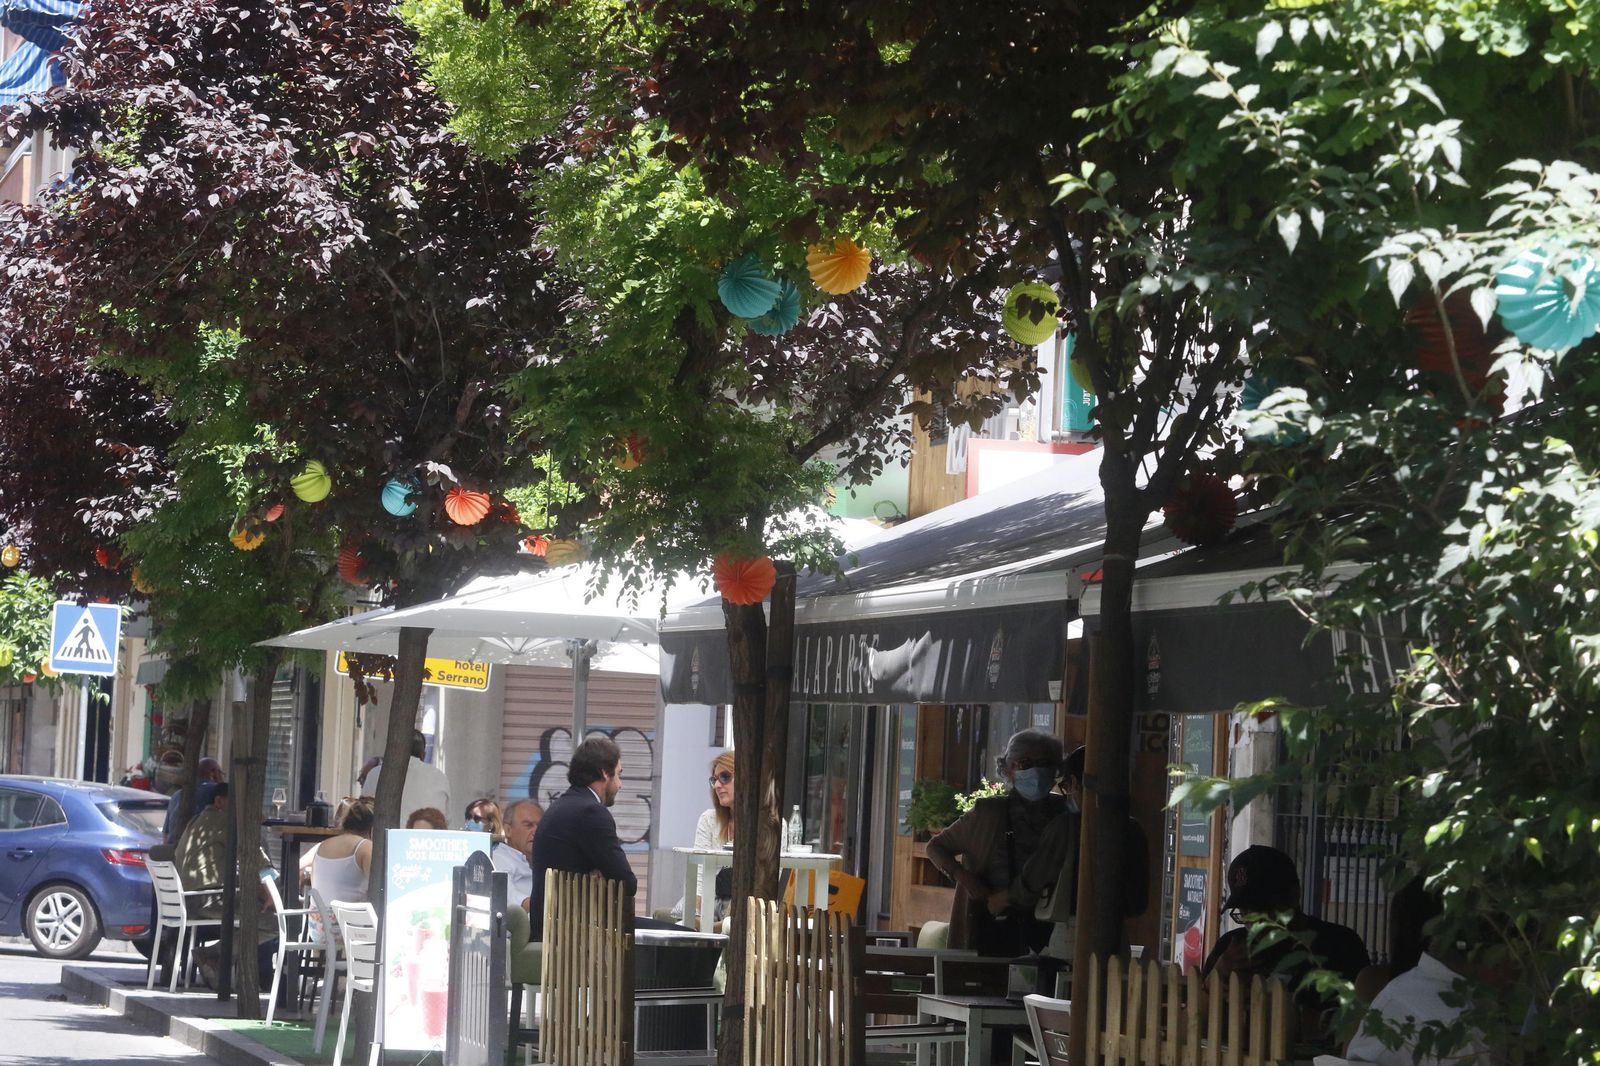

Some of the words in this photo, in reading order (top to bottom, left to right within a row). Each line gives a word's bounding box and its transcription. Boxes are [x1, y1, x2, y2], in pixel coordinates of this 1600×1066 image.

[454, 660, 486, 672] hotel
[792, 634, 880, 695] ALAPARTE
[437, 671, 485, 686] Serrano
[409, 837, 469, 852] SMOOTHIES
